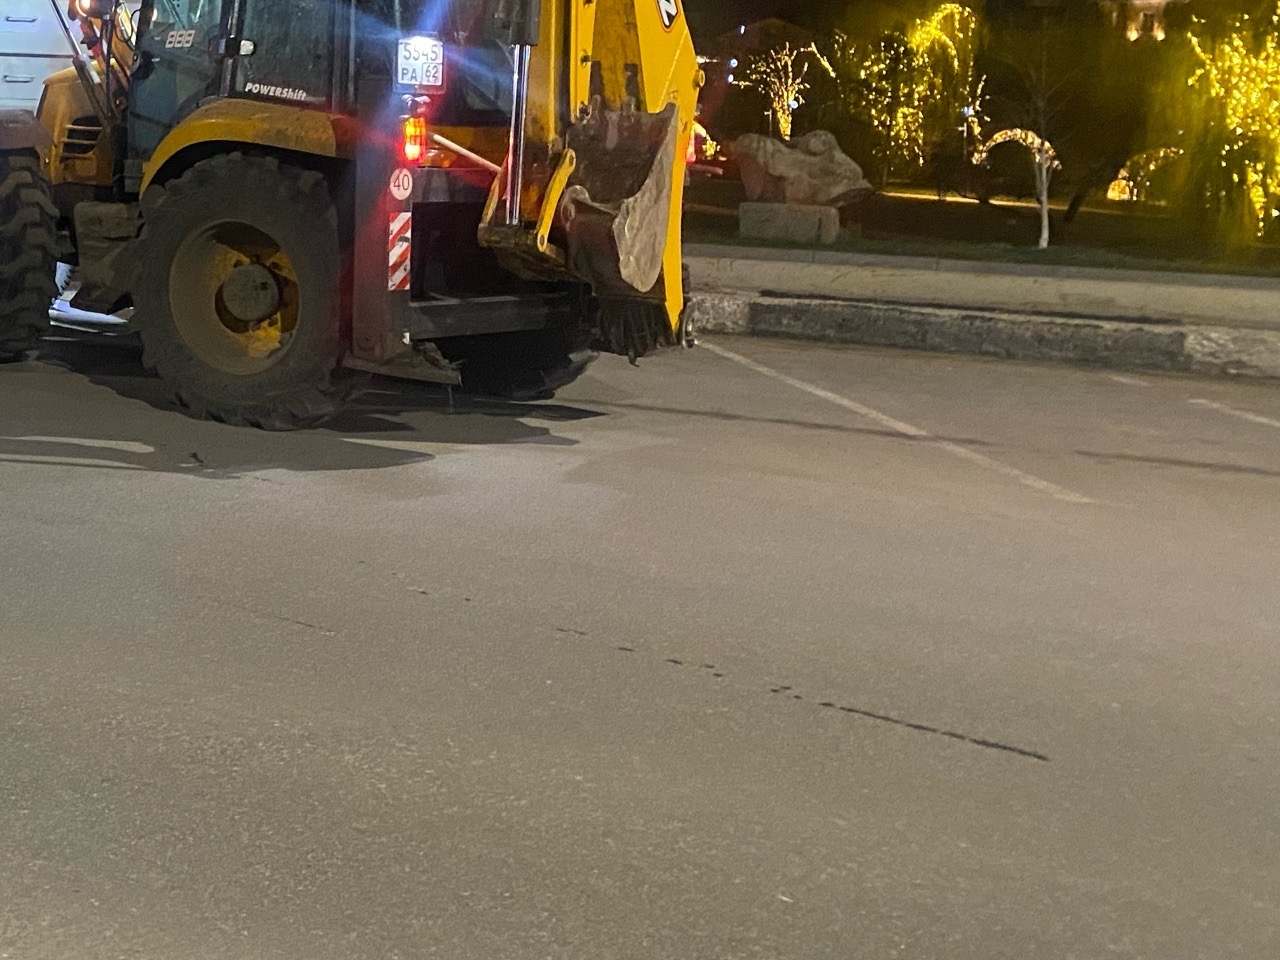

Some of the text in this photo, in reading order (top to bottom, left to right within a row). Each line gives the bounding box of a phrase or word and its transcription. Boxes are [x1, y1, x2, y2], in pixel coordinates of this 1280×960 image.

[165, 30, 195, 48] 888
[425, 65, 438, 78] 62
[245, 82, 307, 101] POWERShift
[393, 174, 410, 191] 40
